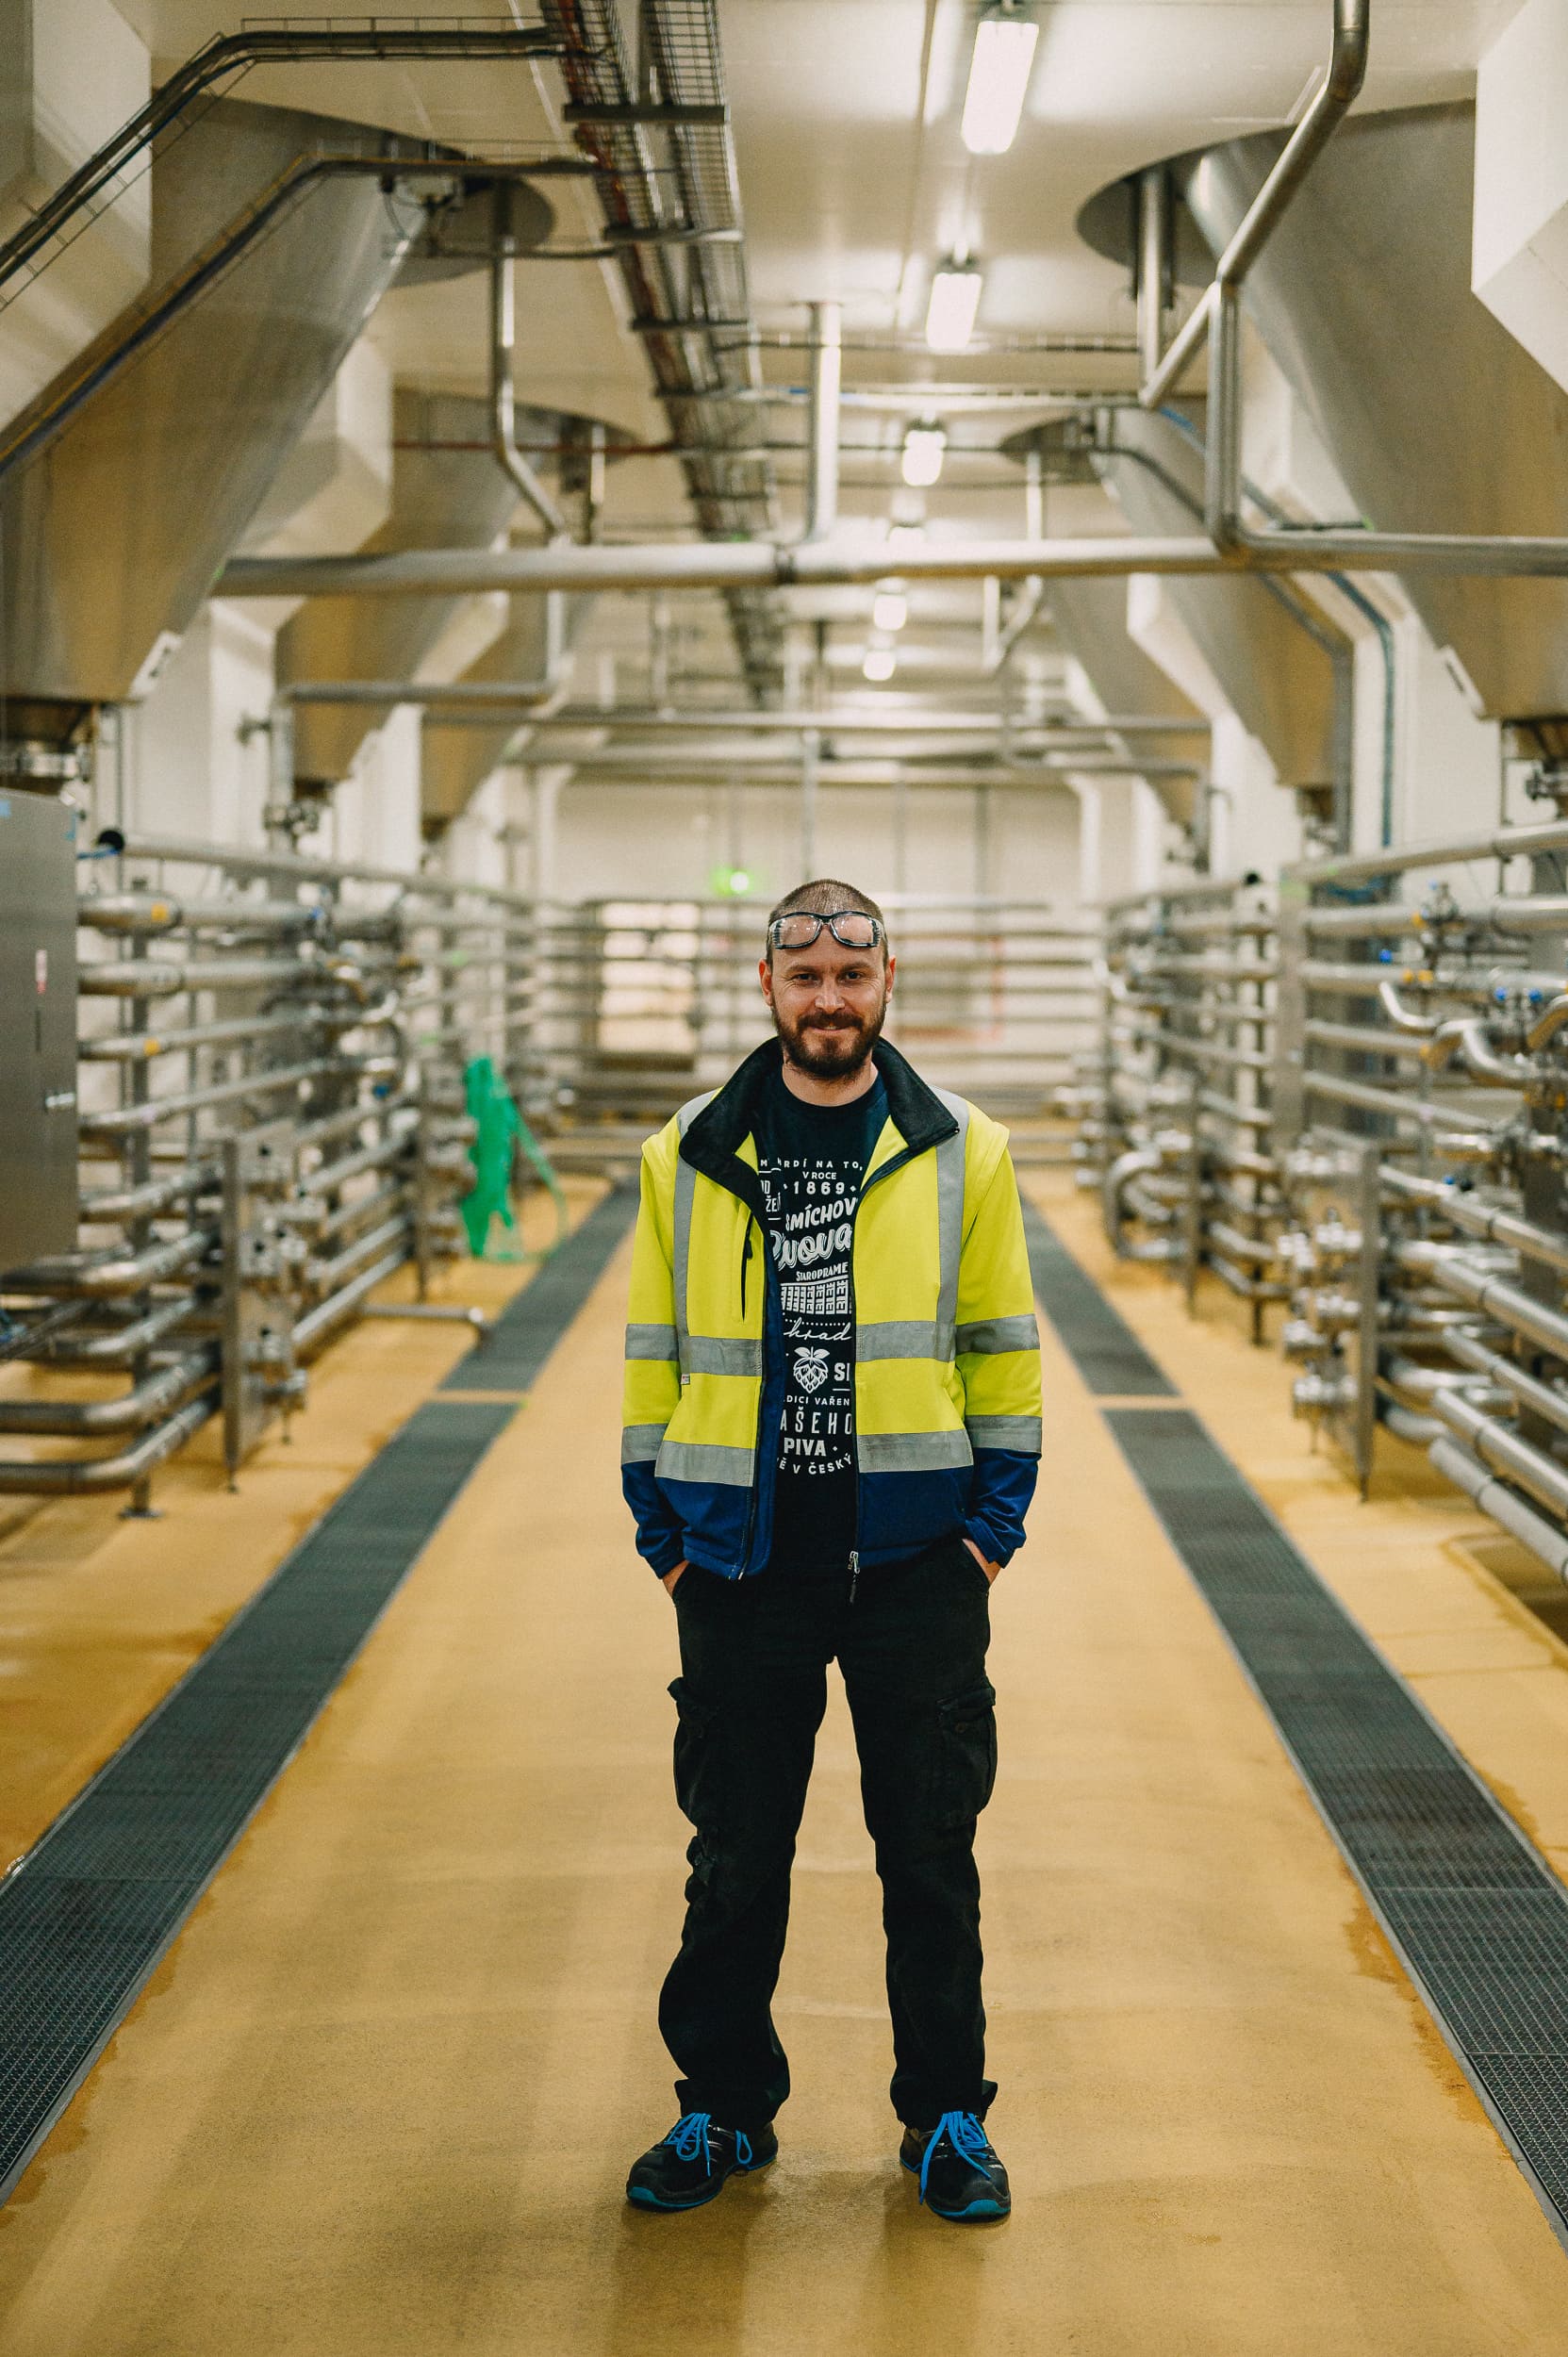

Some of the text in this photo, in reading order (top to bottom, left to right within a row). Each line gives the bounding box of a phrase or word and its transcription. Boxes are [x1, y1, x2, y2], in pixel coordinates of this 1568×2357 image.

[816, 1160, 834, 1168] NA
[843, 1161, 863, 1172] TO,
[801, 1171, 837, 1180] V ROCE
[793, 1181, 845, 1195] 1869
[785, 1196, 859, 1231] SMÍCHOV
[796, 1261, 849, 1282] STAROPRAME
[783, 1394, 809, 1405] DICI
[780, 1406, 852, 1435] AŠEHO
[784, 1437, 827, 1457] PIVA
[793, 1463, 801, 1474] V
